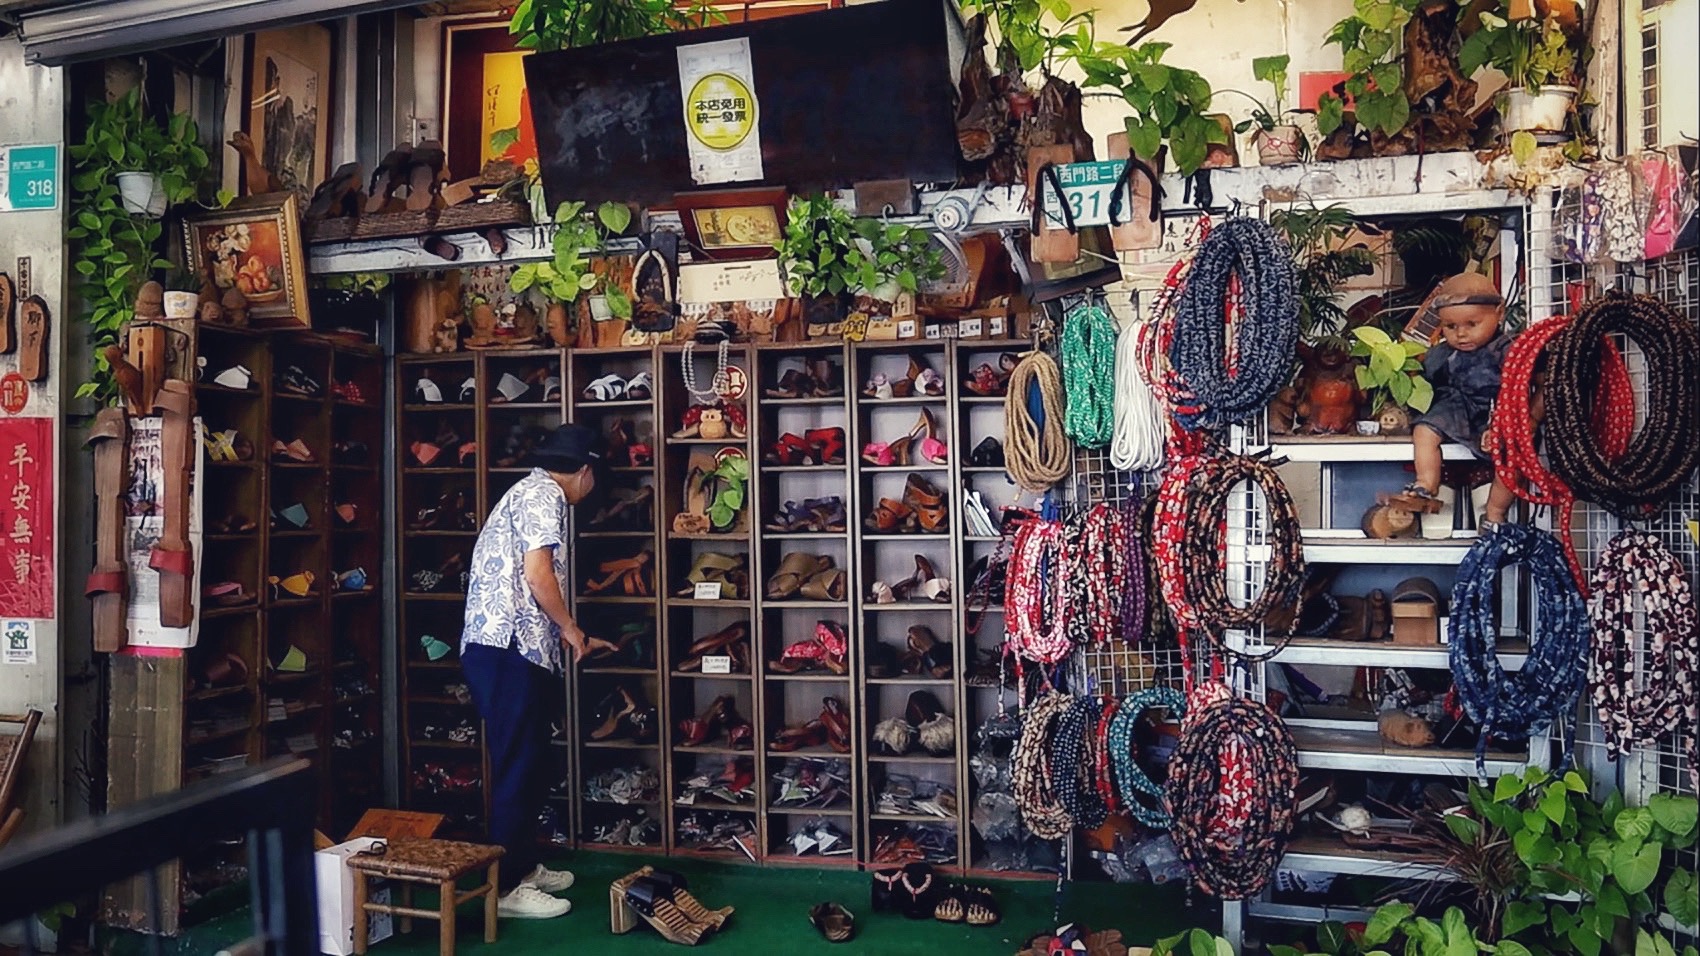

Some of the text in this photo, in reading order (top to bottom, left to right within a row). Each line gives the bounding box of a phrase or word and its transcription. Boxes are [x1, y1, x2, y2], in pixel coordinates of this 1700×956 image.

[695, 98, 746, 110] 本店免用
[697, 111, 746, 123] 統一發票
[1059, 163, 1125, 184] 西門路二段
[27, 179, 53, 196] 318
[9, 442, 34, 585] 平安無事
